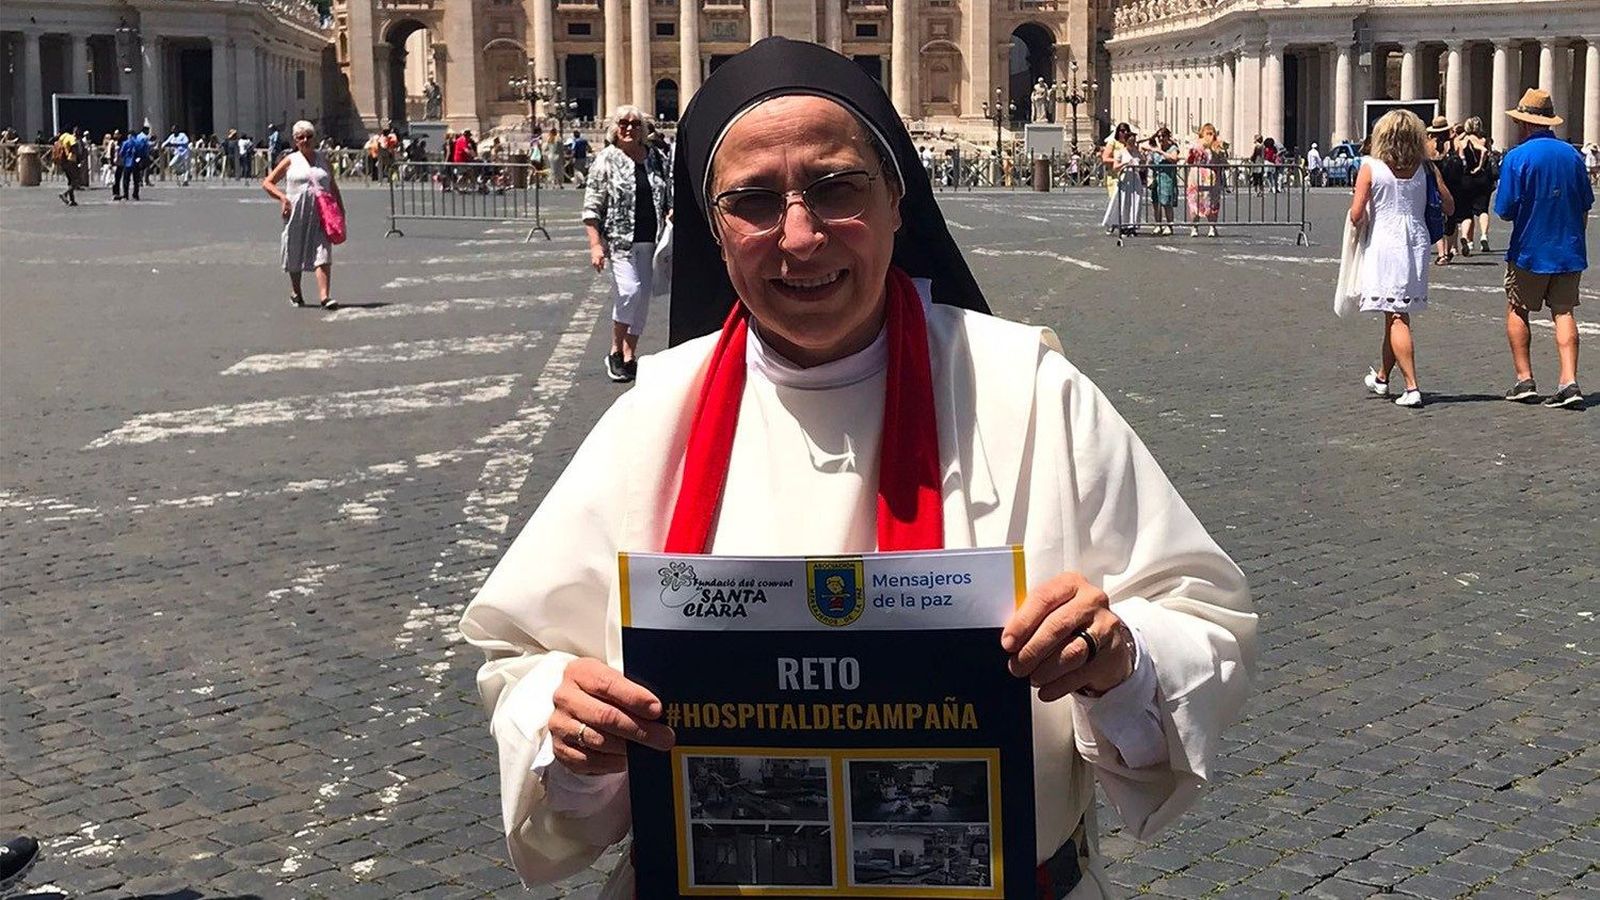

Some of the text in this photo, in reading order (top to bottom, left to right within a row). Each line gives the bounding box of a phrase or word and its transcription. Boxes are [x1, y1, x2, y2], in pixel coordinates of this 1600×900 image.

[693, 578, 794, 587] Fundació del convent
[872, 571, 972, 589] Mensajeros
[700, 588, 768, 603] SANTA
[873, 593, 953, 610] de la paz
[683, 602, 748, 617] CLARA
[777, 657, 861, 690] RETO
[666, 697, 979, 730] #HOSPITALDECAMPAÑA
